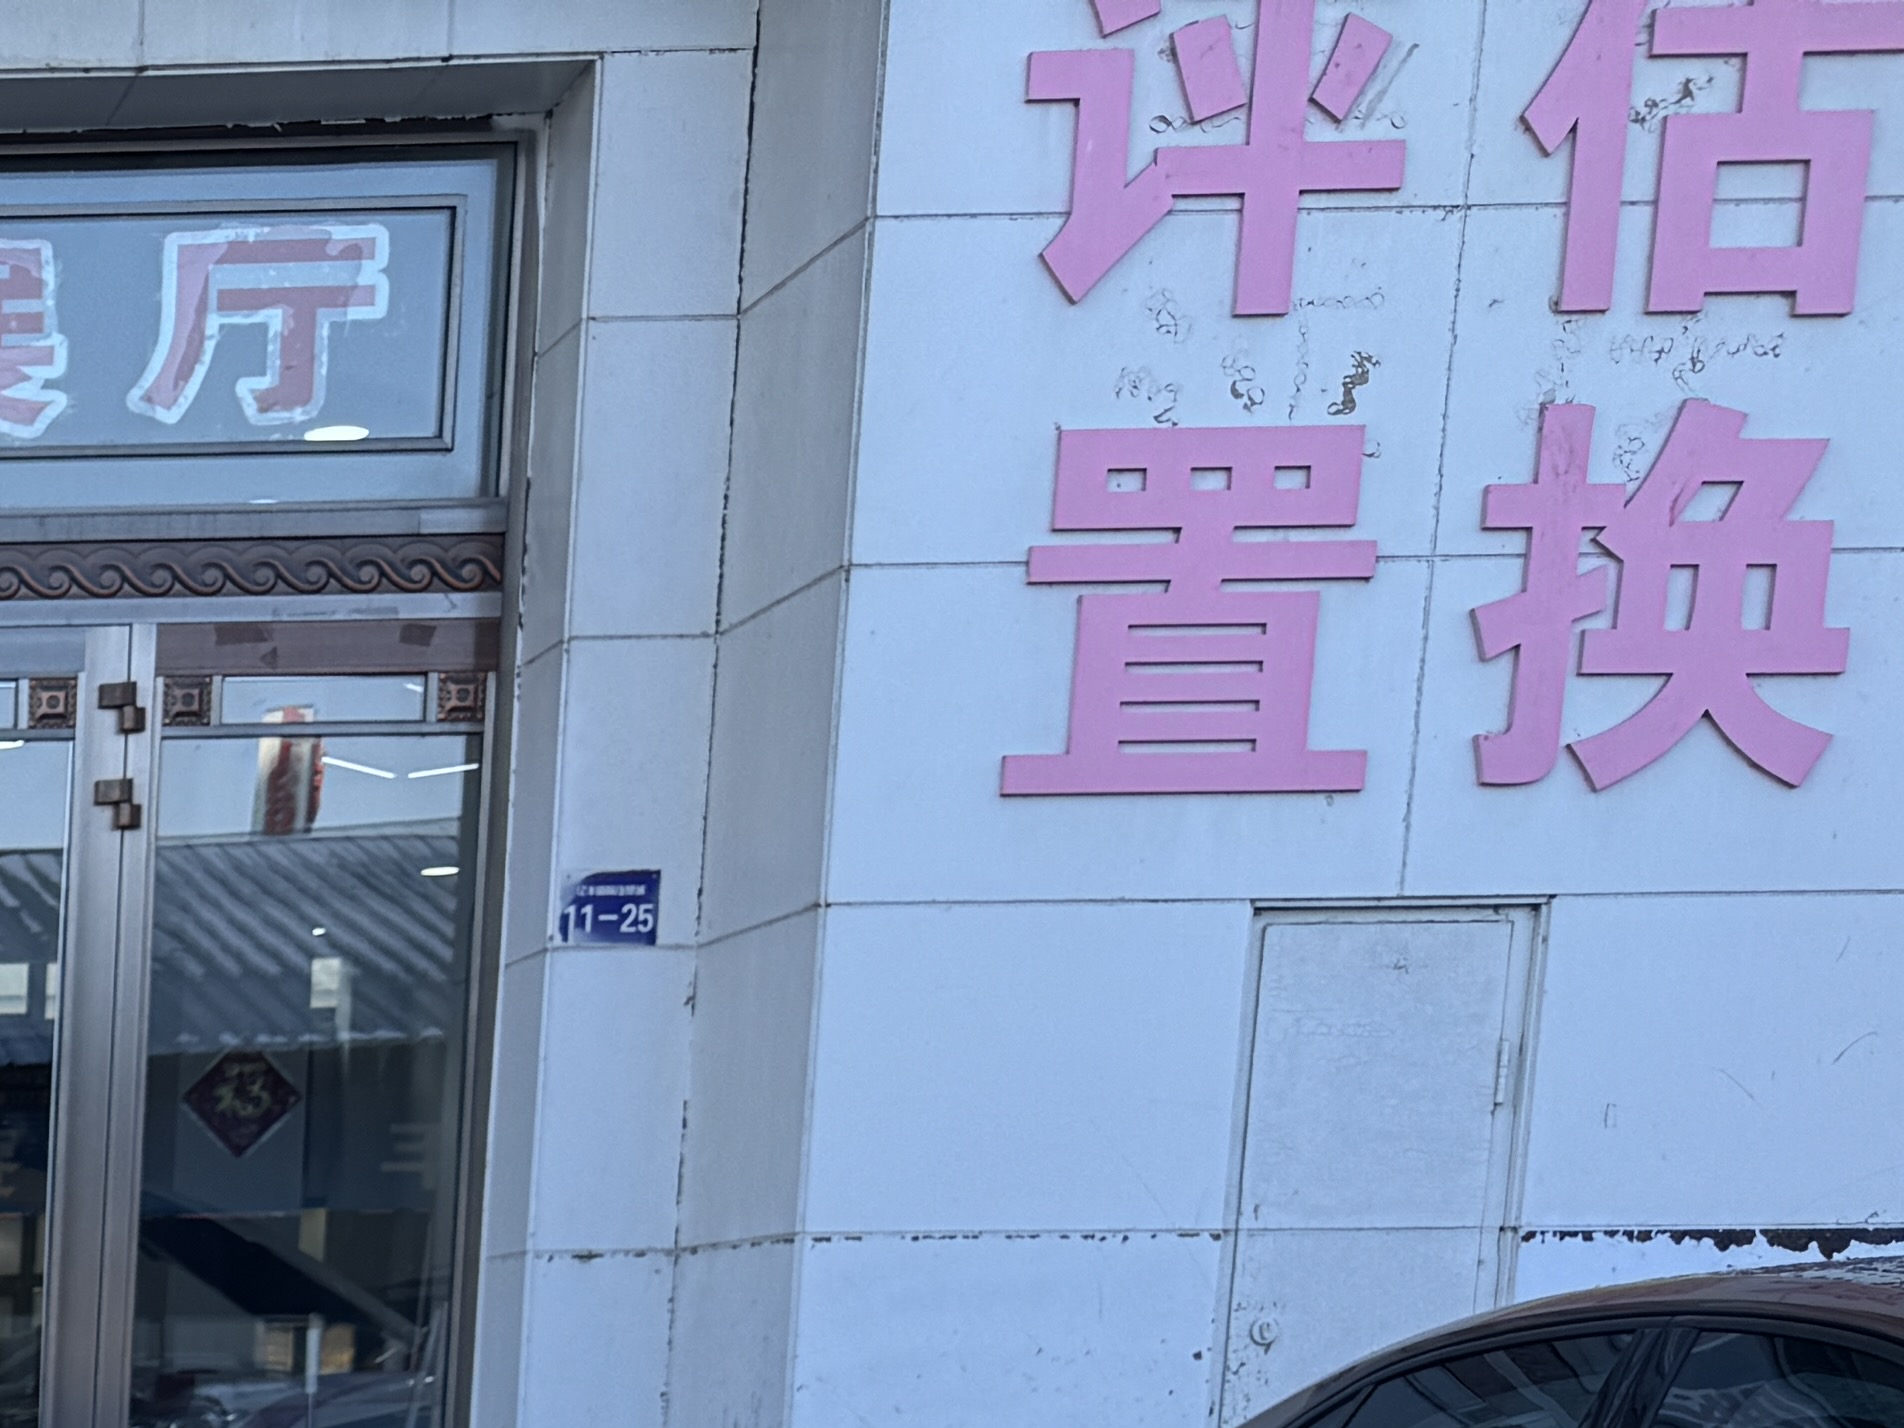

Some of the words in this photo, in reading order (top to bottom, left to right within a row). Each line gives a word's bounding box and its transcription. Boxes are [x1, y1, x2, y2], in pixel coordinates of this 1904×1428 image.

[1025, 0, 1904, 319] 评估
[1000, 397, 1851, 798] 置换
[563, 902, 655, 938] 11-25
